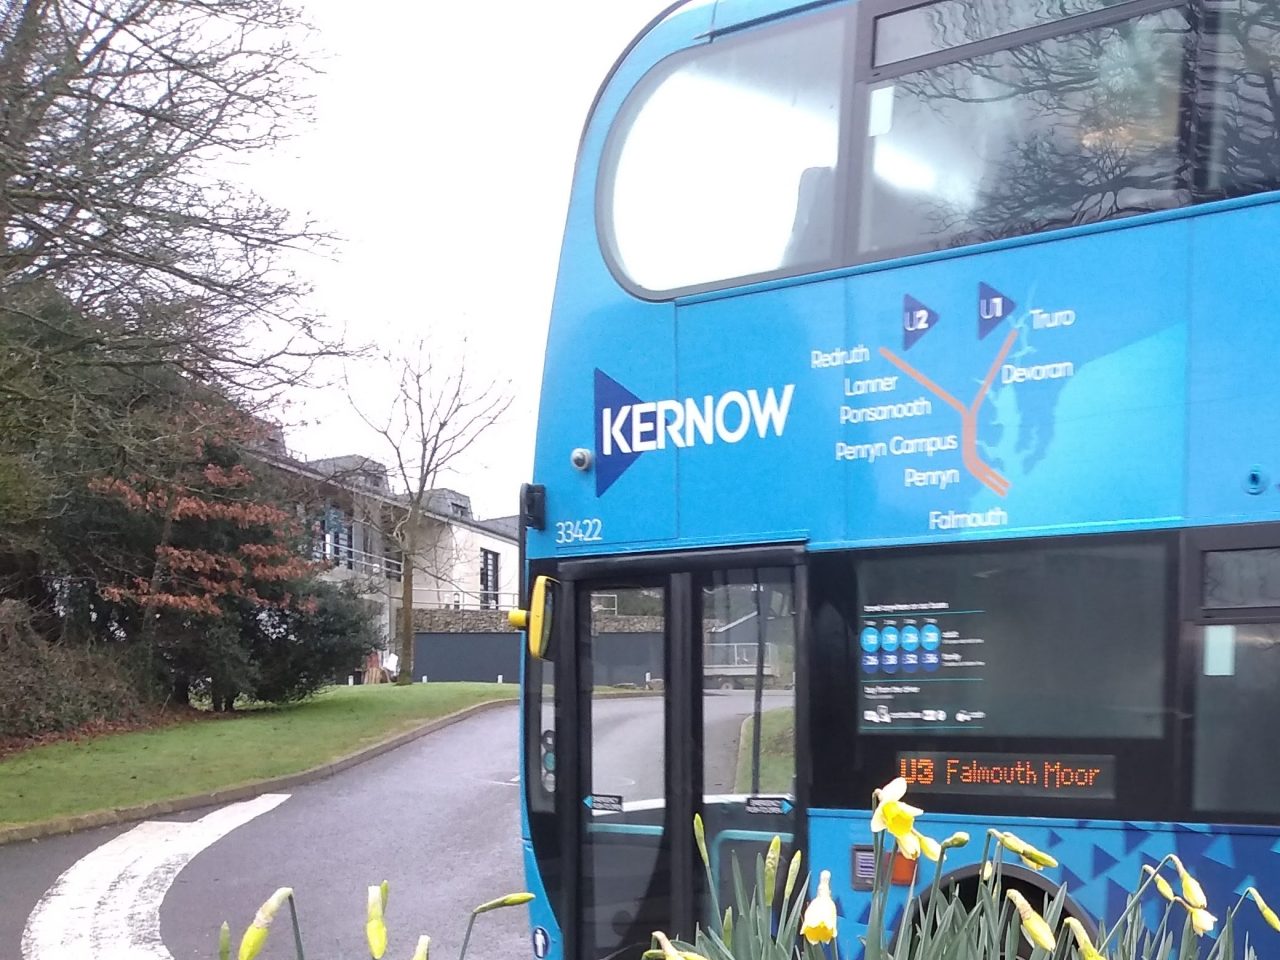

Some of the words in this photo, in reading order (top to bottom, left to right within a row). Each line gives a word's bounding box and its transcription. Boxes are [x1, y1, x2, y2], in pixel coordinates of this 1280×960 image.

[980, 296, 1004, 319] U1
[1029, 308, 1076, 330] Truro
[904, 309, 929, 331] U2
[810, 344, 870, 369] Redruth
[1001, 360, 1074, 385] Devoran
[844, 375, 898, 396] Lanner
[602, 383, 796, 456] KERNOW
[835, 440, 887, 463] Penryn
[889, 433, 958, 457] Campus
[904, 468, 960, 489] Penryn
[929, 507, 1008, 530] Falmouth
[555, 518, 603, 544] 33422
[899, 758, 935, 785] U3
[946, 759, 1038, 785] Falmouth
[1043, 761, 1101, 788] Moor
